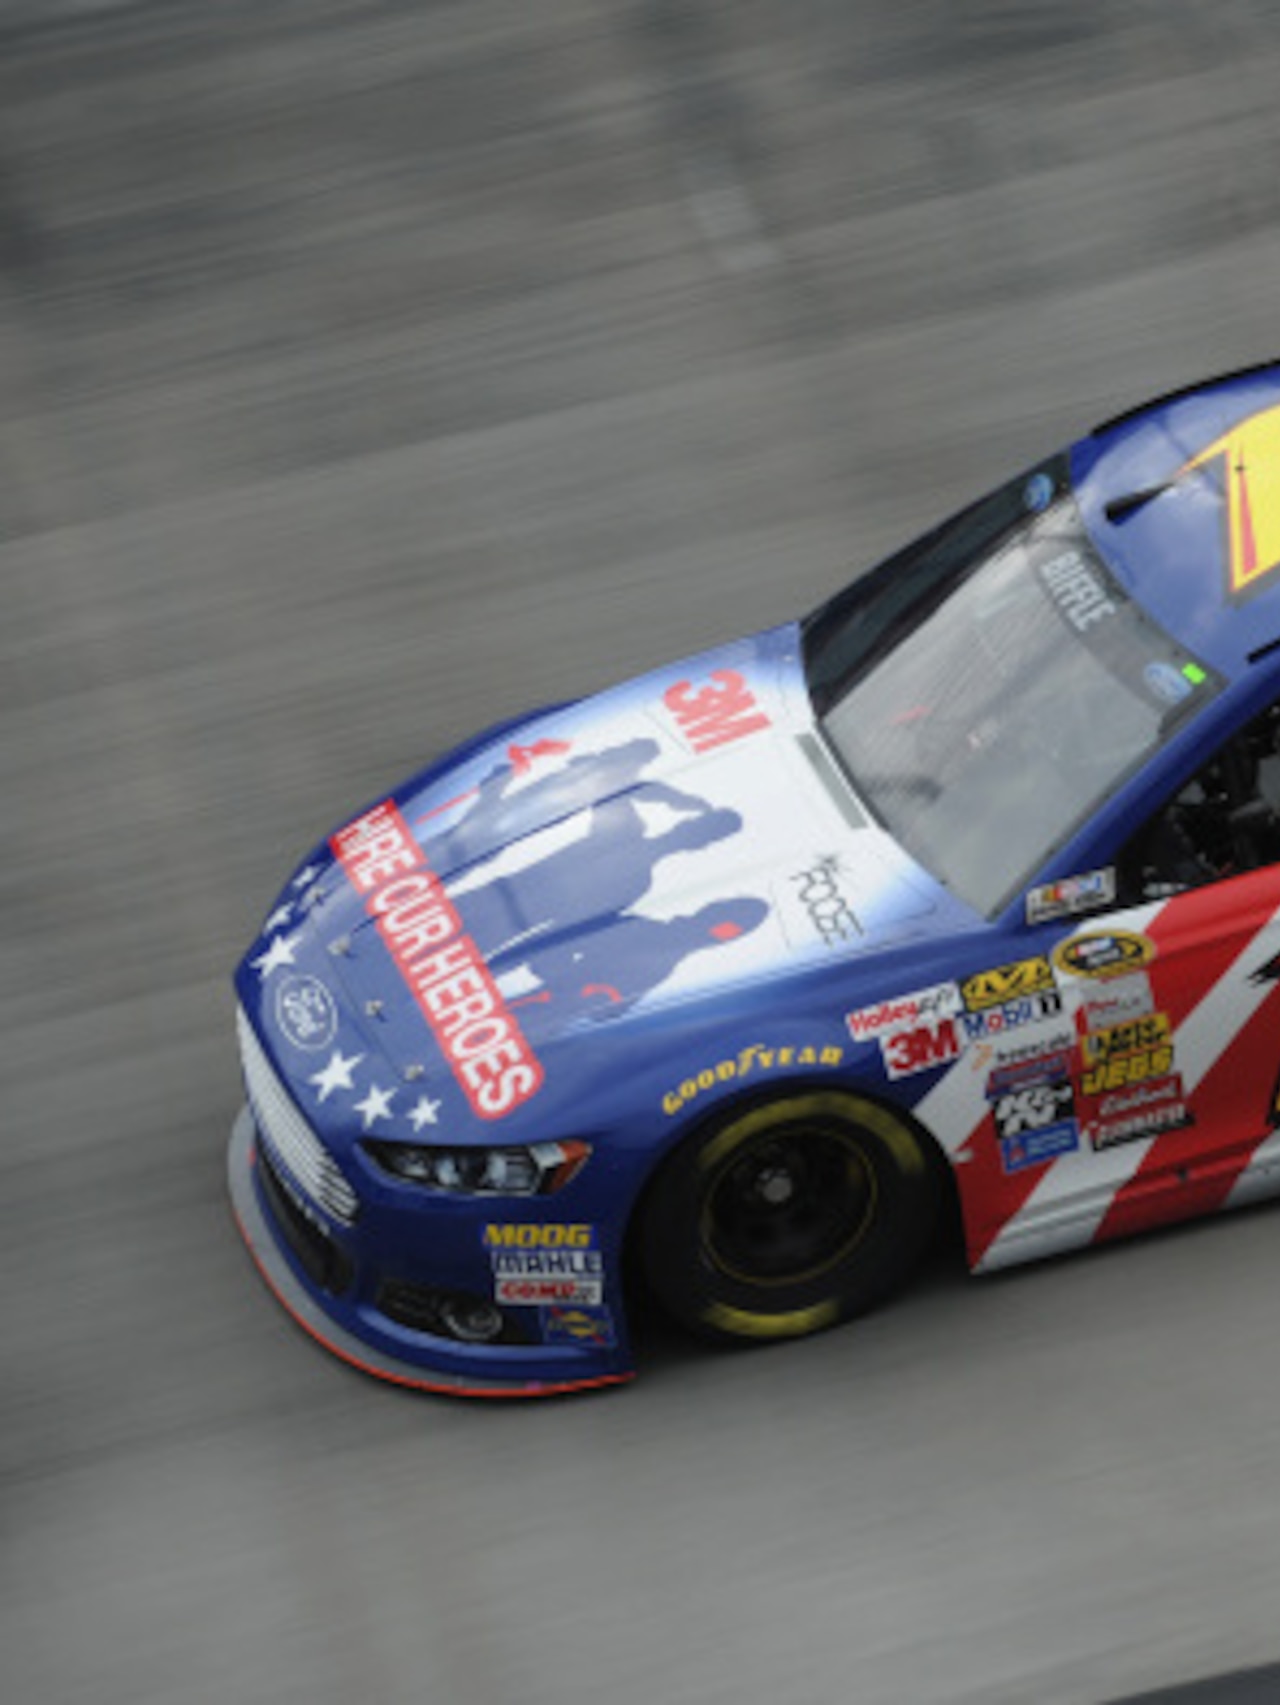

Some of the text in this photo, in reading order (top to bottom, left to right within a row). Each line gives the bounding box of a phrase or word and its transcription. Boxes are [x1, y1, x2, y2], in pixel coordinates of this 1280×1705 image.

[663, 668, 773, 754] 3M
[337, 804, 534, 1112] HIRE OUR HEROES
[887, 1019, 958, 1071] 3M
[1081, 1046, 1173, 1096] JEGS
[662, 1043, 843, 1115] GOODYEAR
[483, 1223, 592, 1249] MOOG
[497, 1252, 600, 1275] MAHLE
